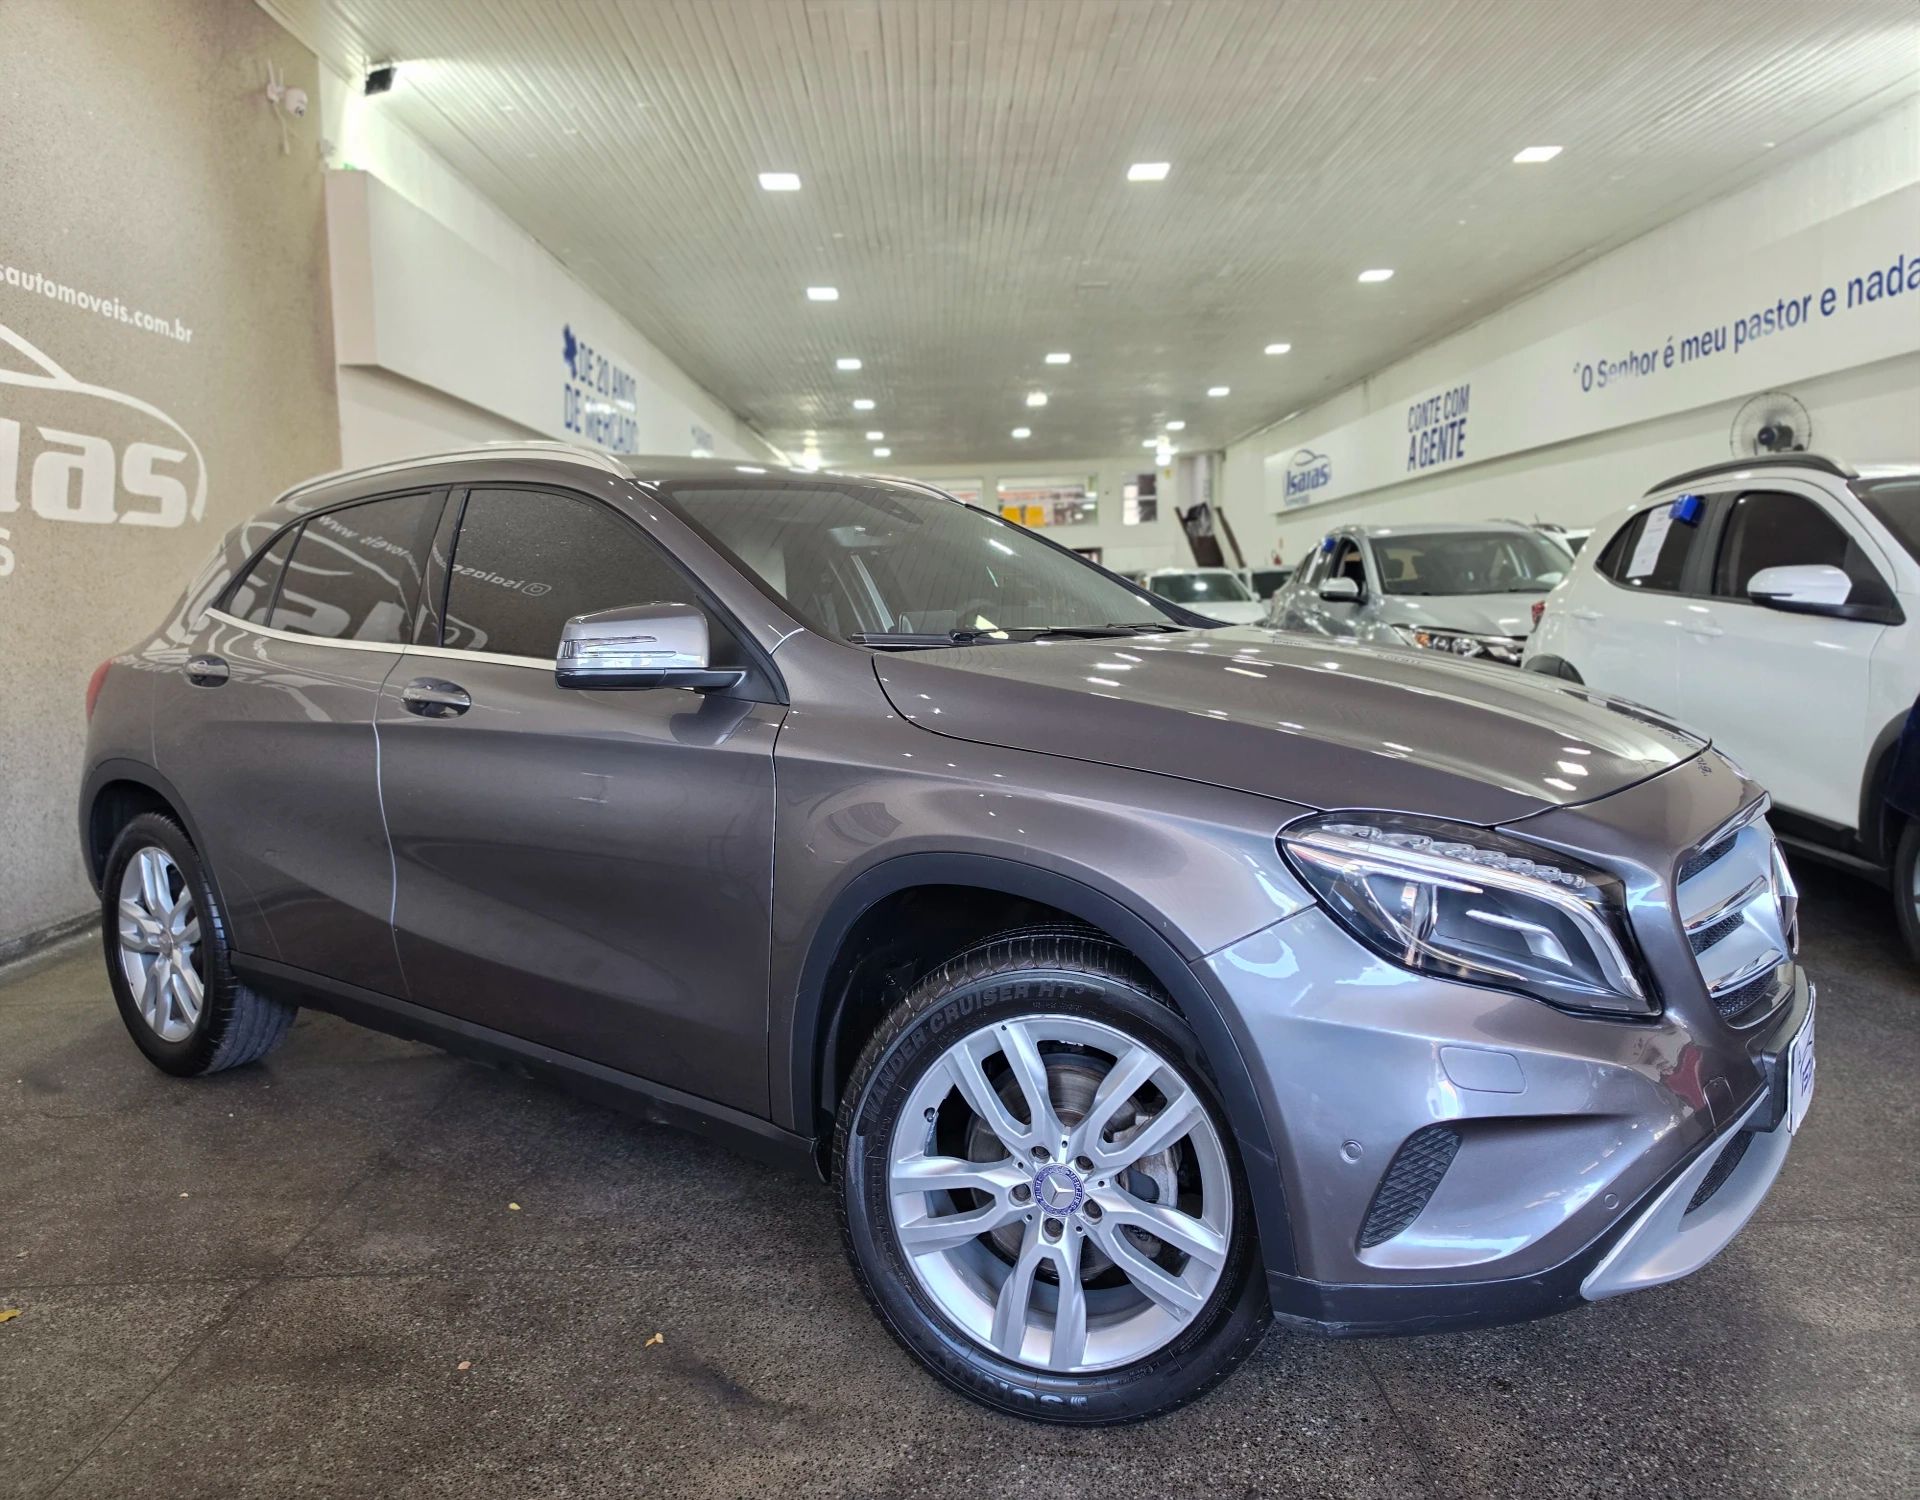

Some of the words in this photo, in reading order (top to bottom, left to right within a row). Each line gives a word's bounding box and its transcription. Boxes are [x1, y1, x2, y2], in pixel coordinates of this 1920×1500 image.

[1597, 348, 1658, 388] Senhor
[1663, 336, 1674, 369] é
[1681, 325, 1726, 364] meu
[1734, 294, 1811, 353] pastor
[1820, 287, 1836, 317] e
[1847, 254, 1920, 308] nada
[1408, 395, 1442, 433] CONTE
[1443, 384, 1470, 421] COM
[1407, 434, 1417, 472] A
[1418, 417, 1467, 469] GENTE
[929, 982, 1032, 1034] CRUISER
